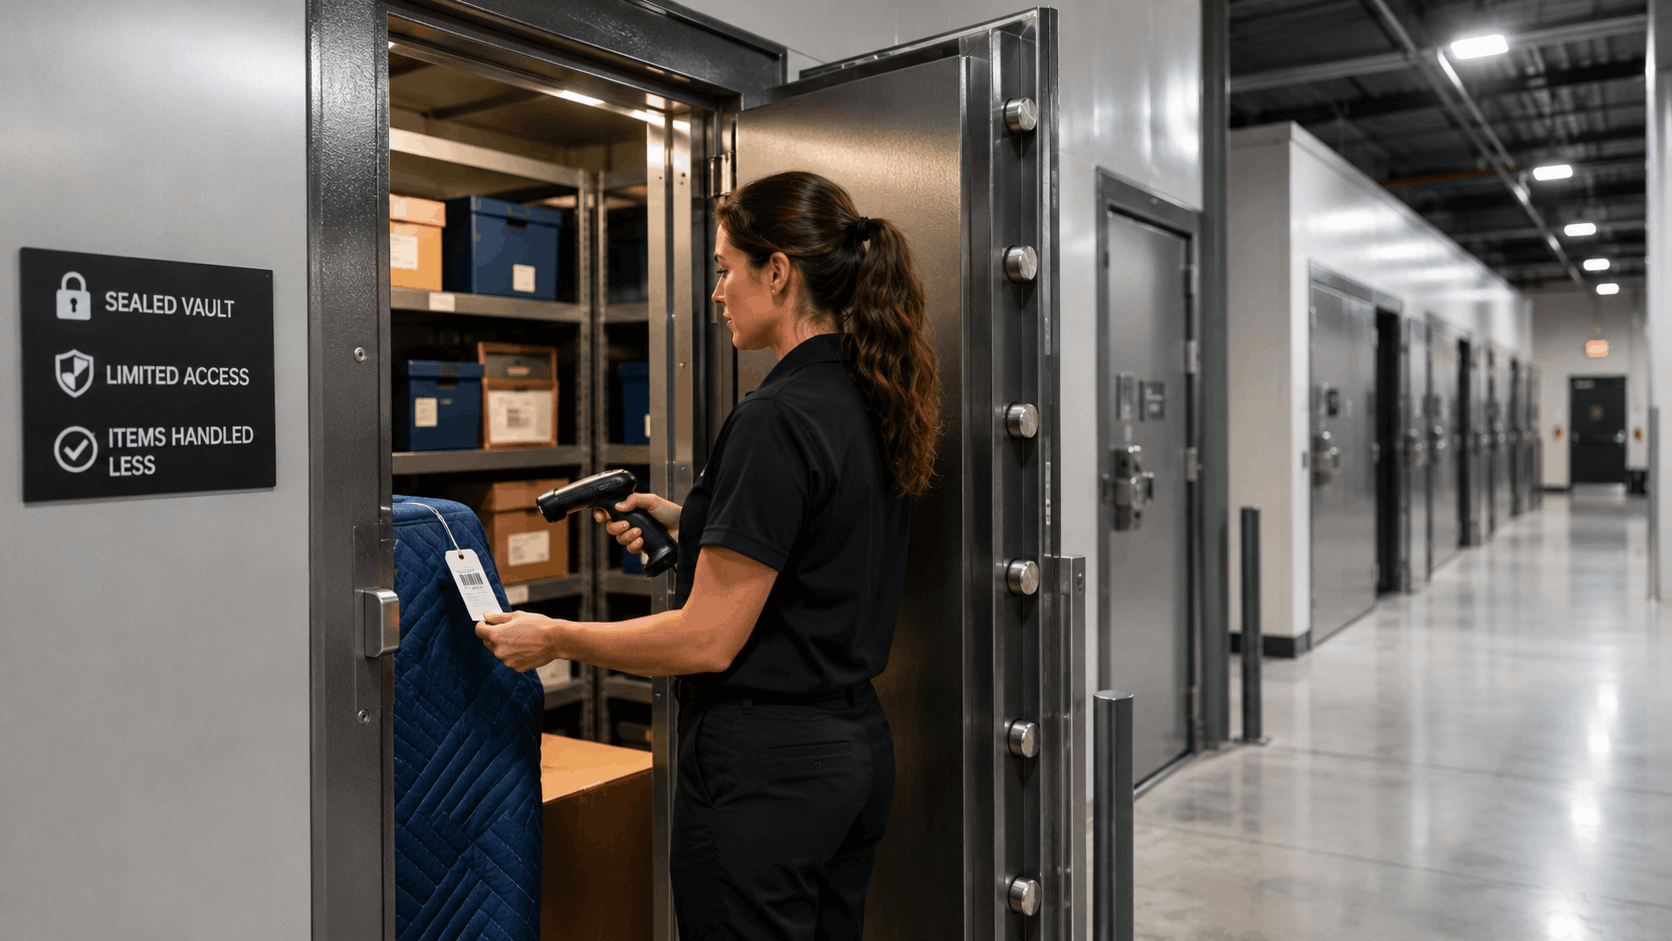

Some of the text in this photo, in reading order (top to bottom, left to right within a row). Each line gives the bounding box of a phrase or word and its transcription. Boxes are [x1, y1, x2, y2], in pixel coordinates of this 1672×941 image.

[105, 291, 235, 318] SEALED VAULT
[106, 364, 250, 386] LIMITED ACCESS
[108, 425, 254, 448] ITEMS HANDLED
[108, 455, 156, 476] LESS
